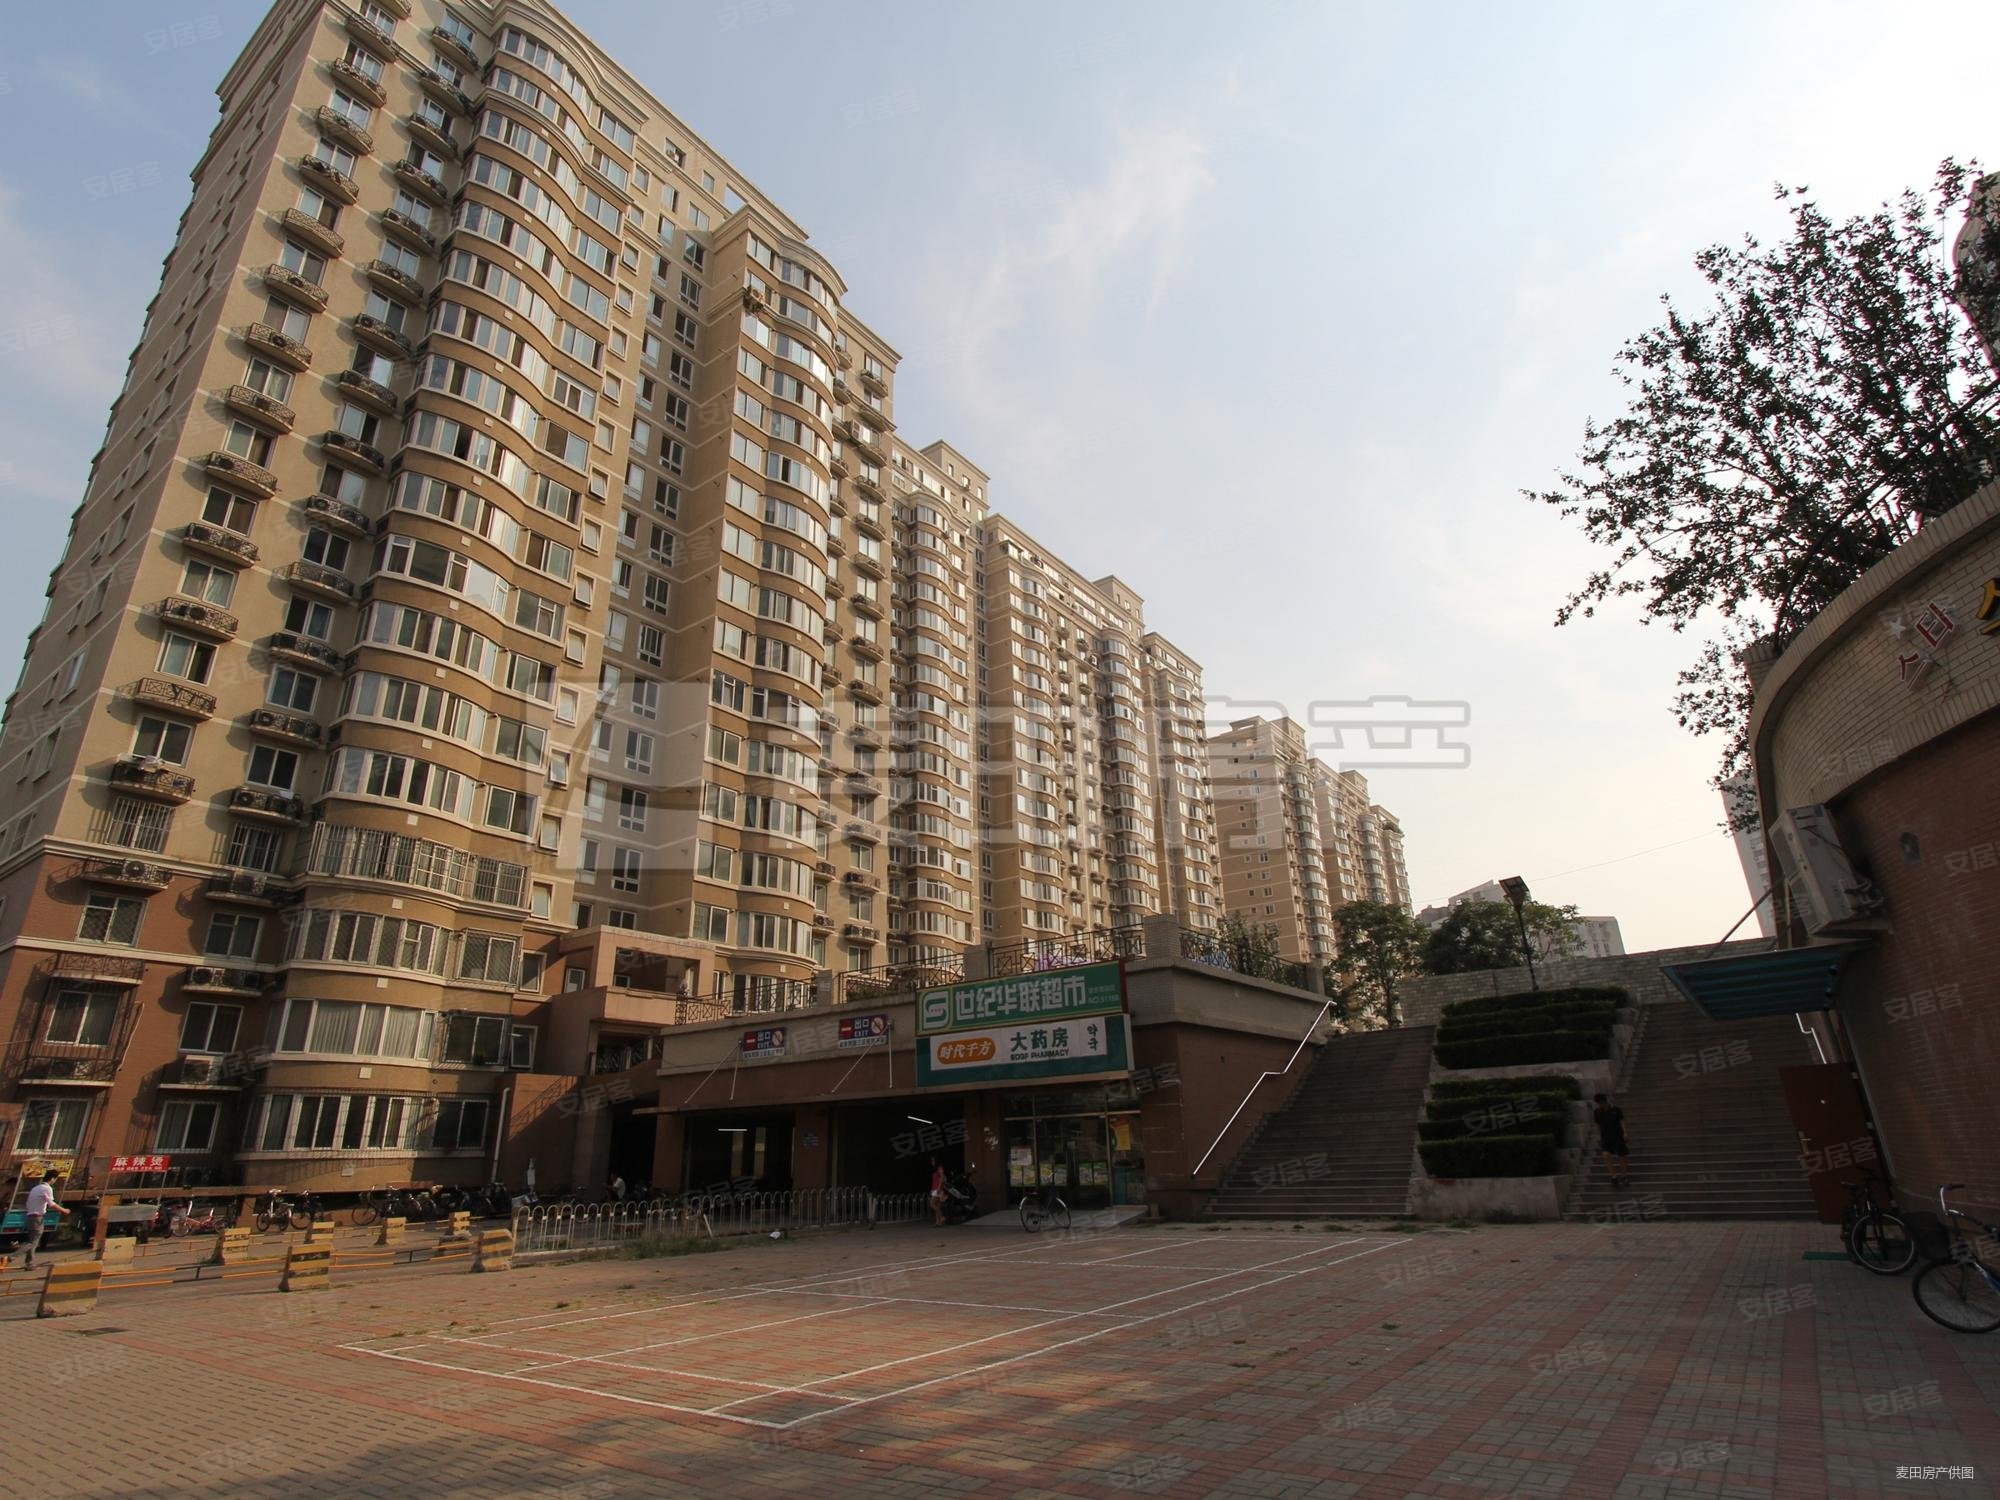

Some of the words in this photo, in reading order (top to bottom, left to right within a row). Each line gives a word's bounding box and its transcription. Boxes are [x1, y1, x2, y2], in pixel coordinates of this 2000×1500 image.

[955, 975, 1087, 1021] 世纪华联超市
[854, 1017, 870, 1030] 出口
[1010, 1027, 1069, 1052] 大药房
[939, 1041, 992, 1060] 时代千方
[114, 1156, 164, 1167] 麻辣烫
